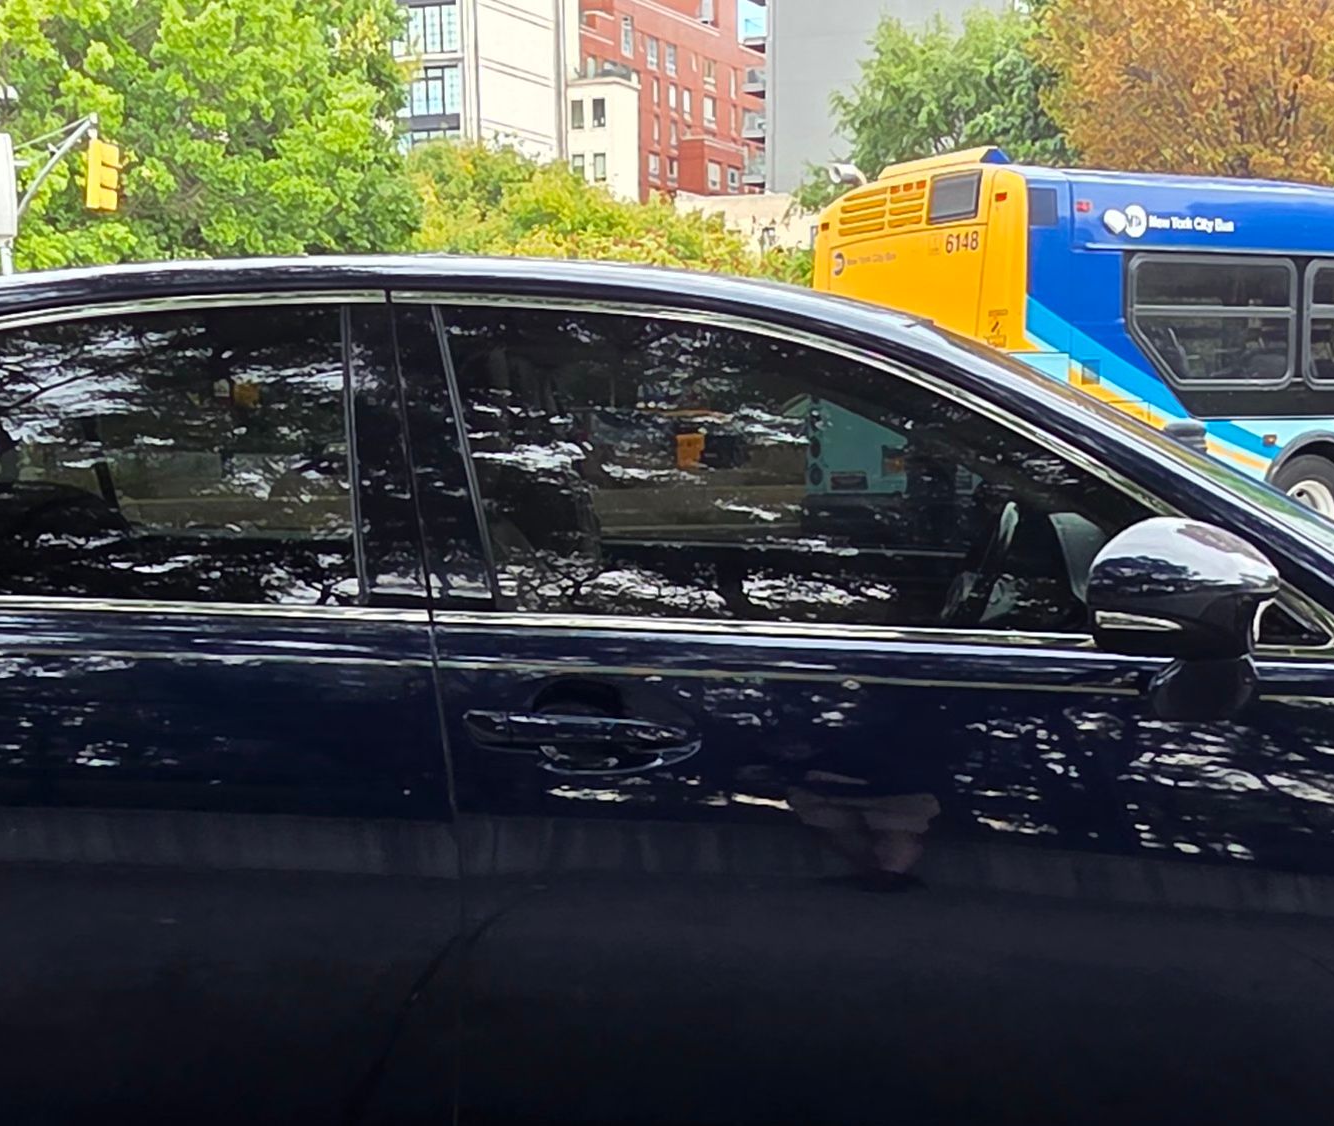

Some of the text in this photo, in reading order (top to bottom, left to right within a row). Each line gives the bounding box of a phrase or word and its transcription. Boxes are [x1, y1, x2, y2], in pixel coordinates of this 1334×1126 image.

[1149, 215, 1170, 228] New
[1171, 217, 1192, 229] York
[1194, 217, 1214, 233] City
[946, 231, 979, 254] 6148
